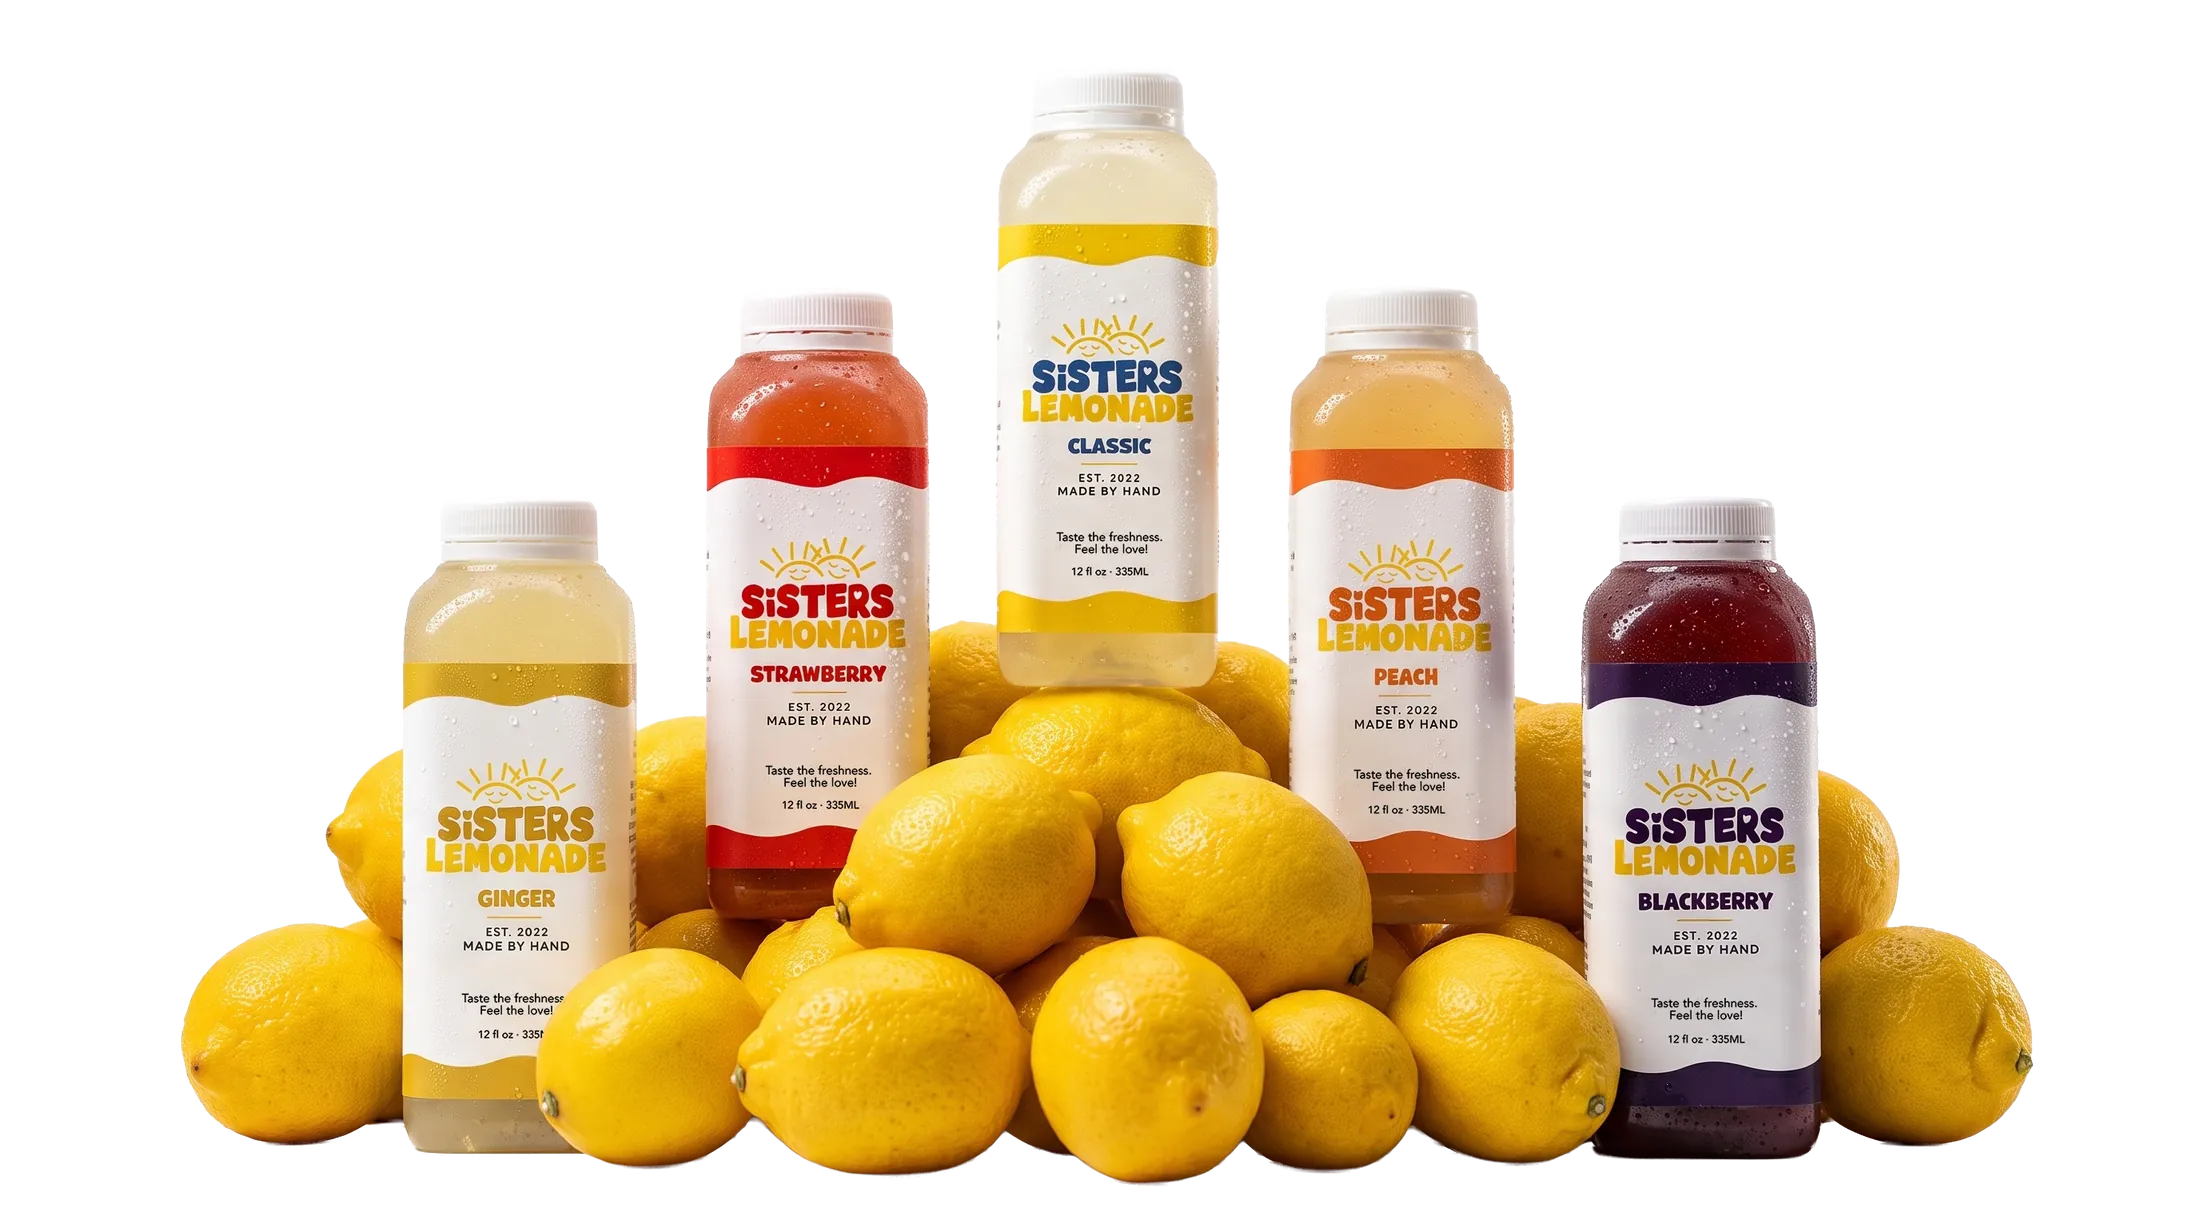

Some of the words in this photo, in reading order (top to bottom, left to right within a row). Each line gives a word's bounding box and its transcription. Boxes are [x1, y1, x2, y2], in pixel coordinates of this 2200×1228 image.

[1022, 390, 1194, 423] LEMONADE
[1068, 438, 1151, 454] CLASSIC
[1079, 474, 1104, 483] EST.
[1110, 474, 1140, 483] 2022
[1058, 487, 1096, 496] MADE
[1101, 487, 1117, 496] BY
[1123, 487, 1161, 496] HAND
[1057, 532, 1086, 542] Taste
[1088, 532, 1106, 542] the
[1109, 532, 1163, 542] freshness.
[1074, 544, 1097, 554] Feel
[1101, 544, 1119, 554] the
[1122, 544, 1148, 554] love!
[1072, 567, 1083, 576] 12
[1085, 567, 1092, 576] fl
[1115, 567, 1148, 576] 335ML
[730, 615, 906, 649] LEMONADE
[1318, 618, 1492, 652] LEMONADE
[750, 665, 887, 683] STRAWBERRY
[1374, 668, 1438, 686] PEACH
[789, 703, 814, 711] EST.
[820, 703, 851, 711] 2022
[1375, 706, 1401, 715] EST.
[1406, 706, 1438, 715] 2022
[767, 716, 805, 726] MADE
[810, 716, 827, 726] BY
[833, 716, 872, 726] HAND
[1354, 719, 1393, 729] MADE
[1398, 719, 1414, 729] BY
[1420, 719, 1458, 729] HAND
[765, 765, 794, 776] Taste
[797, 765, 815, 776] the
[818, 765, 872, 776] freshness.
[1354, 769, 1383, 780] Taste
[1386, 769, 1403, 780] the
[1406, 769, 1460, 780] freshness.
[784, 778, 807, 787] Feel
[810, 778, 828, 787] the
[831, 778, 857, 787] love!
[1372, 782, 1395, 792] Feel
[1398, 782, 1417, 792] the
[1419, 782, 1445, 792] love!
[782, 801, 793, 809] 12
[796, 800, 803, 809] fl
[826, 801, 859, 810] 335ML
[1368, 805, 1379, 814] 12
[1382, 805, 1389, 814] fl
[1412, 805, 1445, 815] 335ML
[426, 837, 606, 873] LEMONADE
[1614, 839, 1796, 876] LEMONADE
[478, 889, 555, 908] GINGER
[1638, 892, 1773, 911] BLACKBERRY
[485, 927, 513, 937] EST.
[517, 927, 548, 937] 2022
[1674, 931, 1700, 940] EST.
[1706, 931, 1738, 940] 2022
[463, 941, 503, 951] MADE
[507, 941, 525, 951] BY
[530, 941, 570, 951] HAND
[1652, 945, 1692, 955] MADE
[1697, 945, 1714, 955] BY
[1719, 945, 1759, 955] HAND
[462, 993, 489, 1003] Taste
[493, 993, 510, 1003] the
[514, 993, 564, 1003] freshness
[1651, 998, 1681, 1009] Taste
[1683, 998, 1701, 1009] the
[1703, 998, 1757, 1009] freshness.
[480, 1005, 502, 1015] Feel
[506, 1005, 523, 1015] the
[527, 1005, 553, 1015] love!
[1670, 1010, 1693, 1020] Feel
[1696, 1010, 1714, 1020] the
[1717, 1010, 1743, 1020] love!
[478, 1030, 489, 1039] 12
[493, 1029, 500, 1039] fl
[1668, 1035, 1680, 1044] 12
[1682, 1034, 1689, 1044] fl
[1711, 1035, 1745, 1044] 335ML
